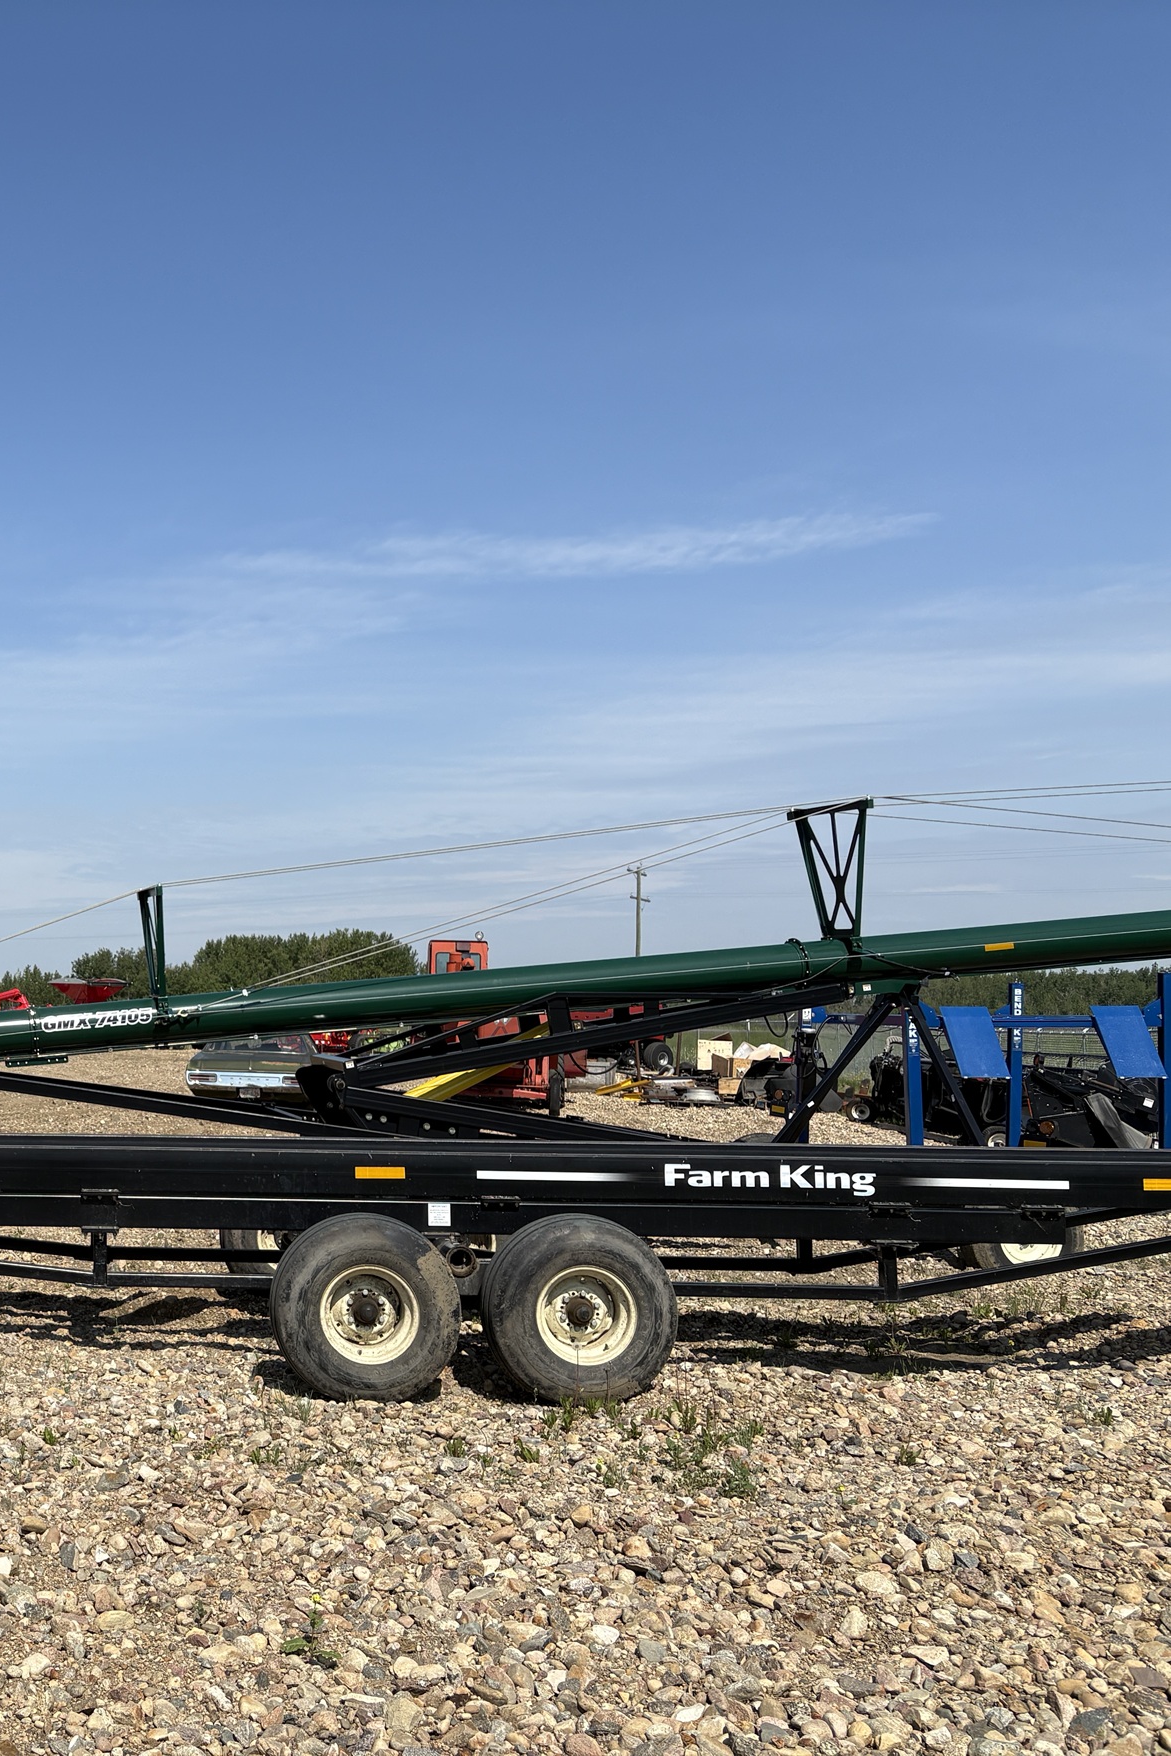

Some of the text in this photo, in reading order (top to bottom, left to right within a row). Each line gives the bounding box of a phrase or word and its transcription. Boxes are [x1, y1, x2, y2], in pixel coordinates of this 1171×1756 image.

[41, 1008, 153, 1032] GMX 74105
[1014, 988, 1022, 1036] BENDK
[664, 1163, 877, 1197] Farm King
